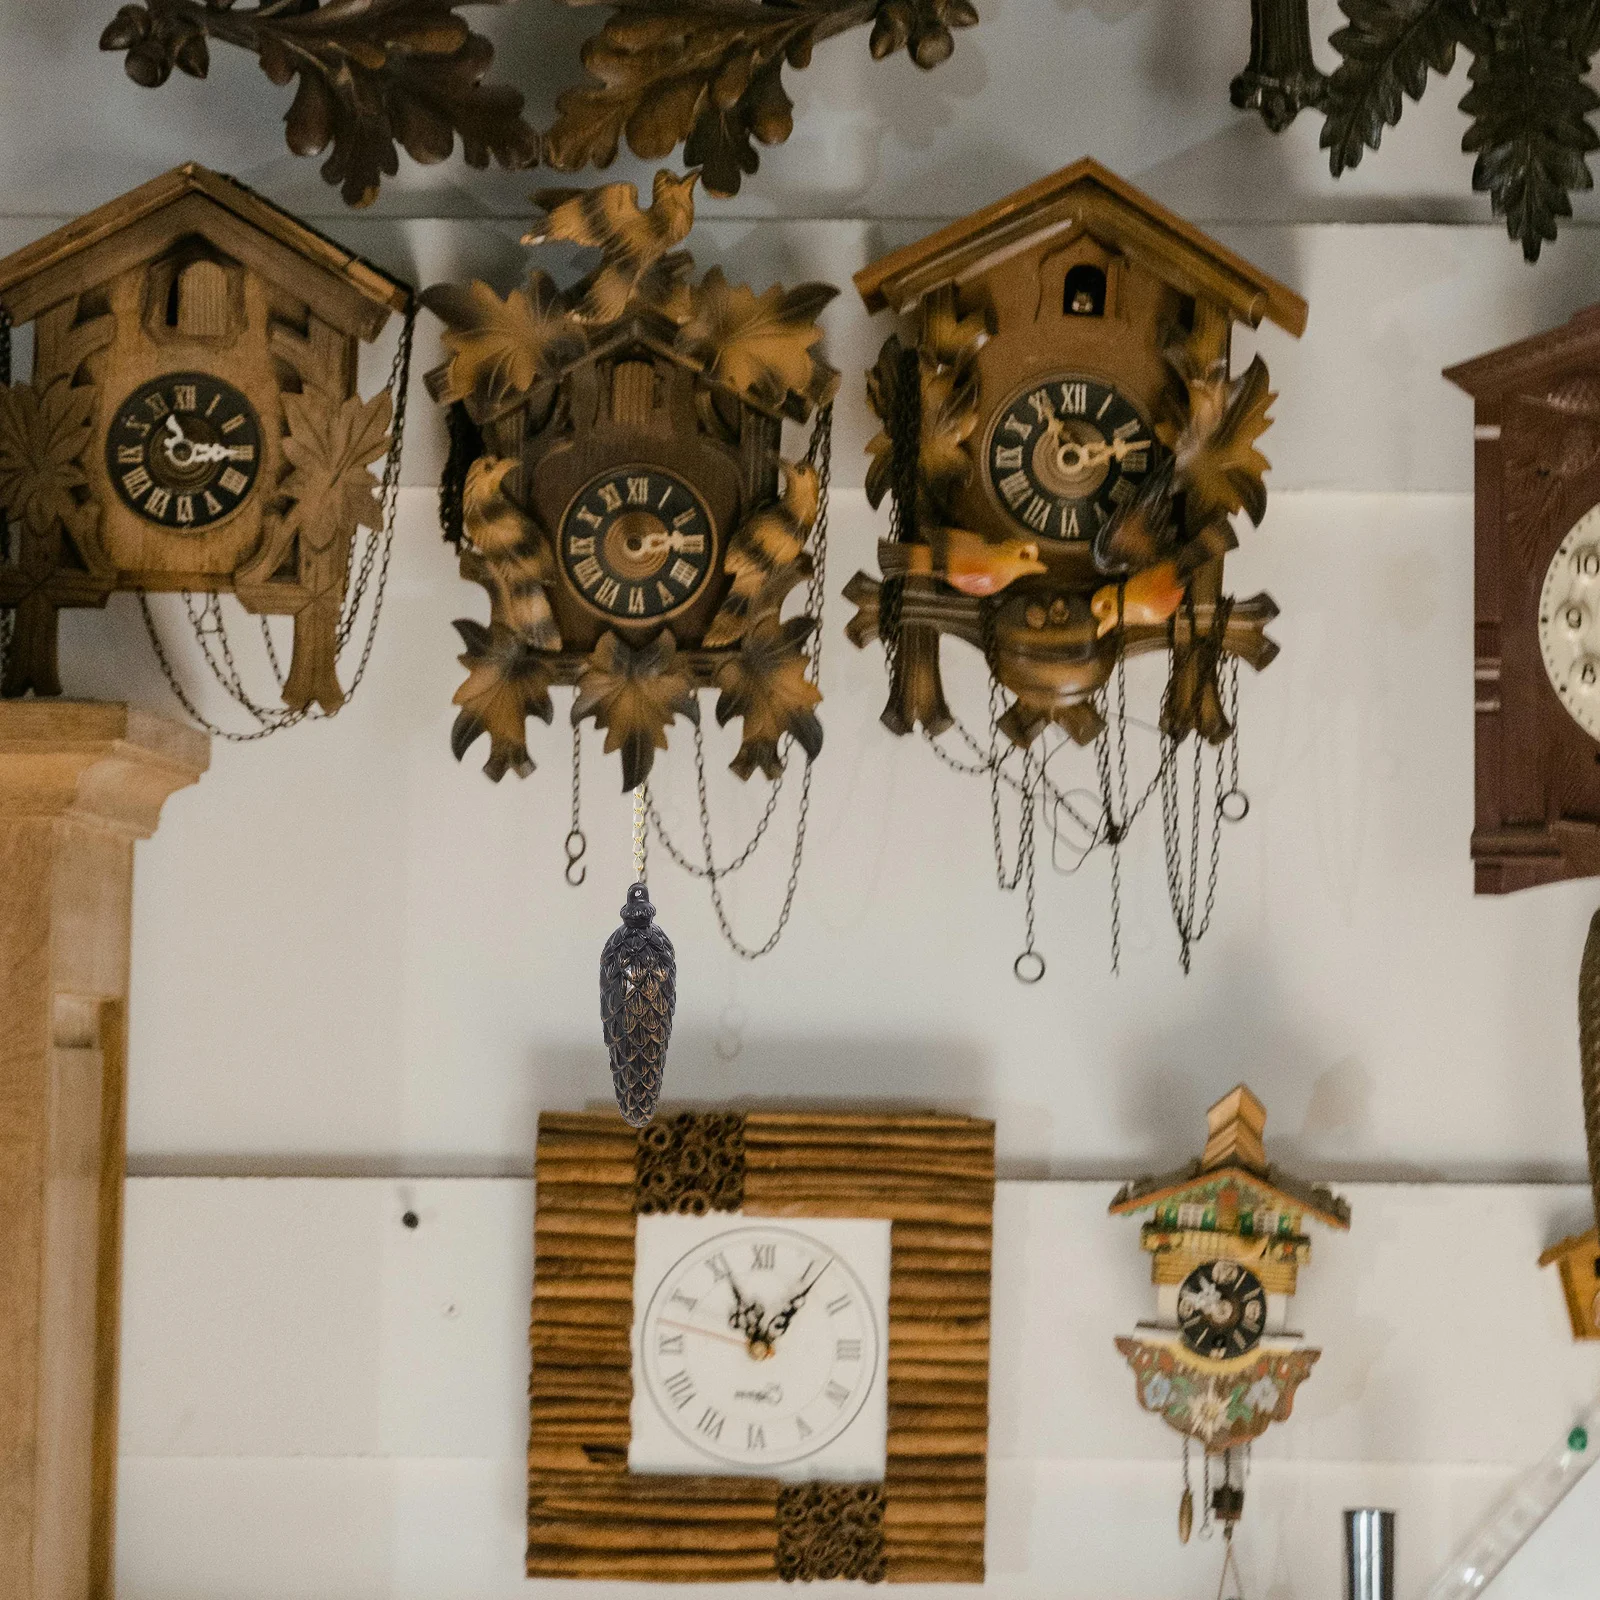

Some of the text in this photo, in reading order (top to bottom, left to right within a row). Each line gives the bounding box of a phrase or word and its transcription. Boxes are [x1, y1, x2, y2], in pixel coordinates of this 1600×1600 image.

[205, 393, 221, 416] I
[1061, 383, 1087, 414] XII
[1096, 393, 1112, 420] I
[1004, 414, 1032, 440] X
[996, 445, 1022, 468] IX
[598, 483, 622, 512] XI
[626, 477, 648, 504] XII
[658, 486, 672, 510] I
[176, 494, 194, 523] VI
[576, 506, 602, 528] X
[672, 508, 696, 528] II
[1022, 494, 1052, 532] VII
[1060, 506, 1080, 538] VI
[570, 536, 594, 555] IX
[1577, 554, 1600, 576] 10
[595, 577, 620, 609] VII
[628, 587, 646, 614] VI
[656, 580, 675, 607] V
[751, 1244, 776, 1270] XII
[826, 1294, 852, 1316] II
[659, 1334, 684, 1356] IX
[664, 1370, 696, 1412] VIII
[697, 1407, 726, 1440] VII
[748, 1422, 766, 1450] VI
